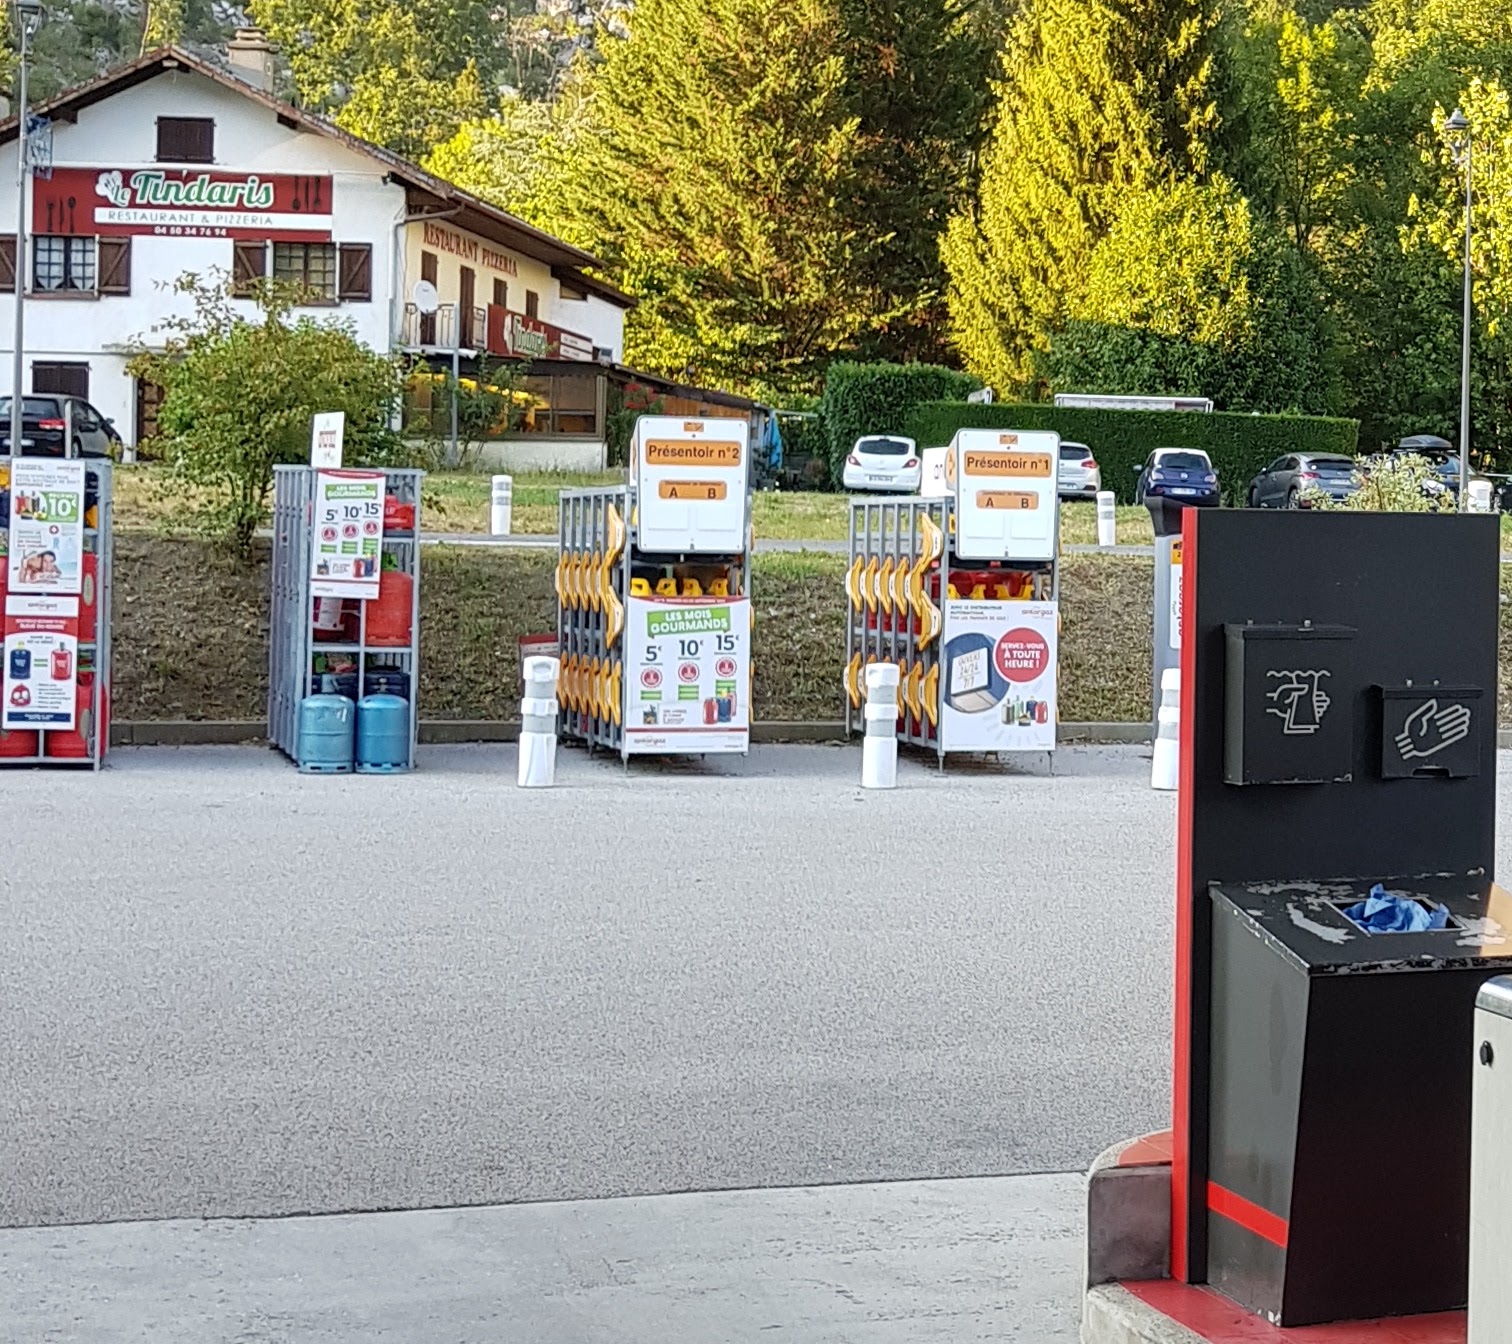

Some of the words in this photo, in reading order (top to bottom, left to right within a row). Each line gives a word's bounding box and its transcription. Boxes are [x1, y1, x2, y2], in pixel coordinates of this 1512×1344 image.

[113, 182, 130, 205] Le
[132, 170, 274, 207] Tindaris
[108, 210, 195, 224] RESTAURANT
[201, 215, 209, 224] &
[216, 214, 273, 225] PIZZERIA
[423, 221, 479, 263] RESTAURANT
[481, 247, 518, 277] PIZZERIA
[649, 444, 715, 458] Présentoir
[718, 446, 740, 459] n°2
[967, 457, 1027, 469] Présentoir
[1030, 459, 1049, 470] n°1
[669, 487, 678, 499] A
[708, 488, 717, 499] B
[985, 497, 994, 508] A
[1021, 498, 1029, 509] B
[665, 611, 681, 622] LES
[684, 609, 711, 621] MOIS
[650, 618, 728, 633] GOURMANDS
[1013, 650, 1041, 659] TOUTE
[1004, 659, 1034, 668] HEURE
